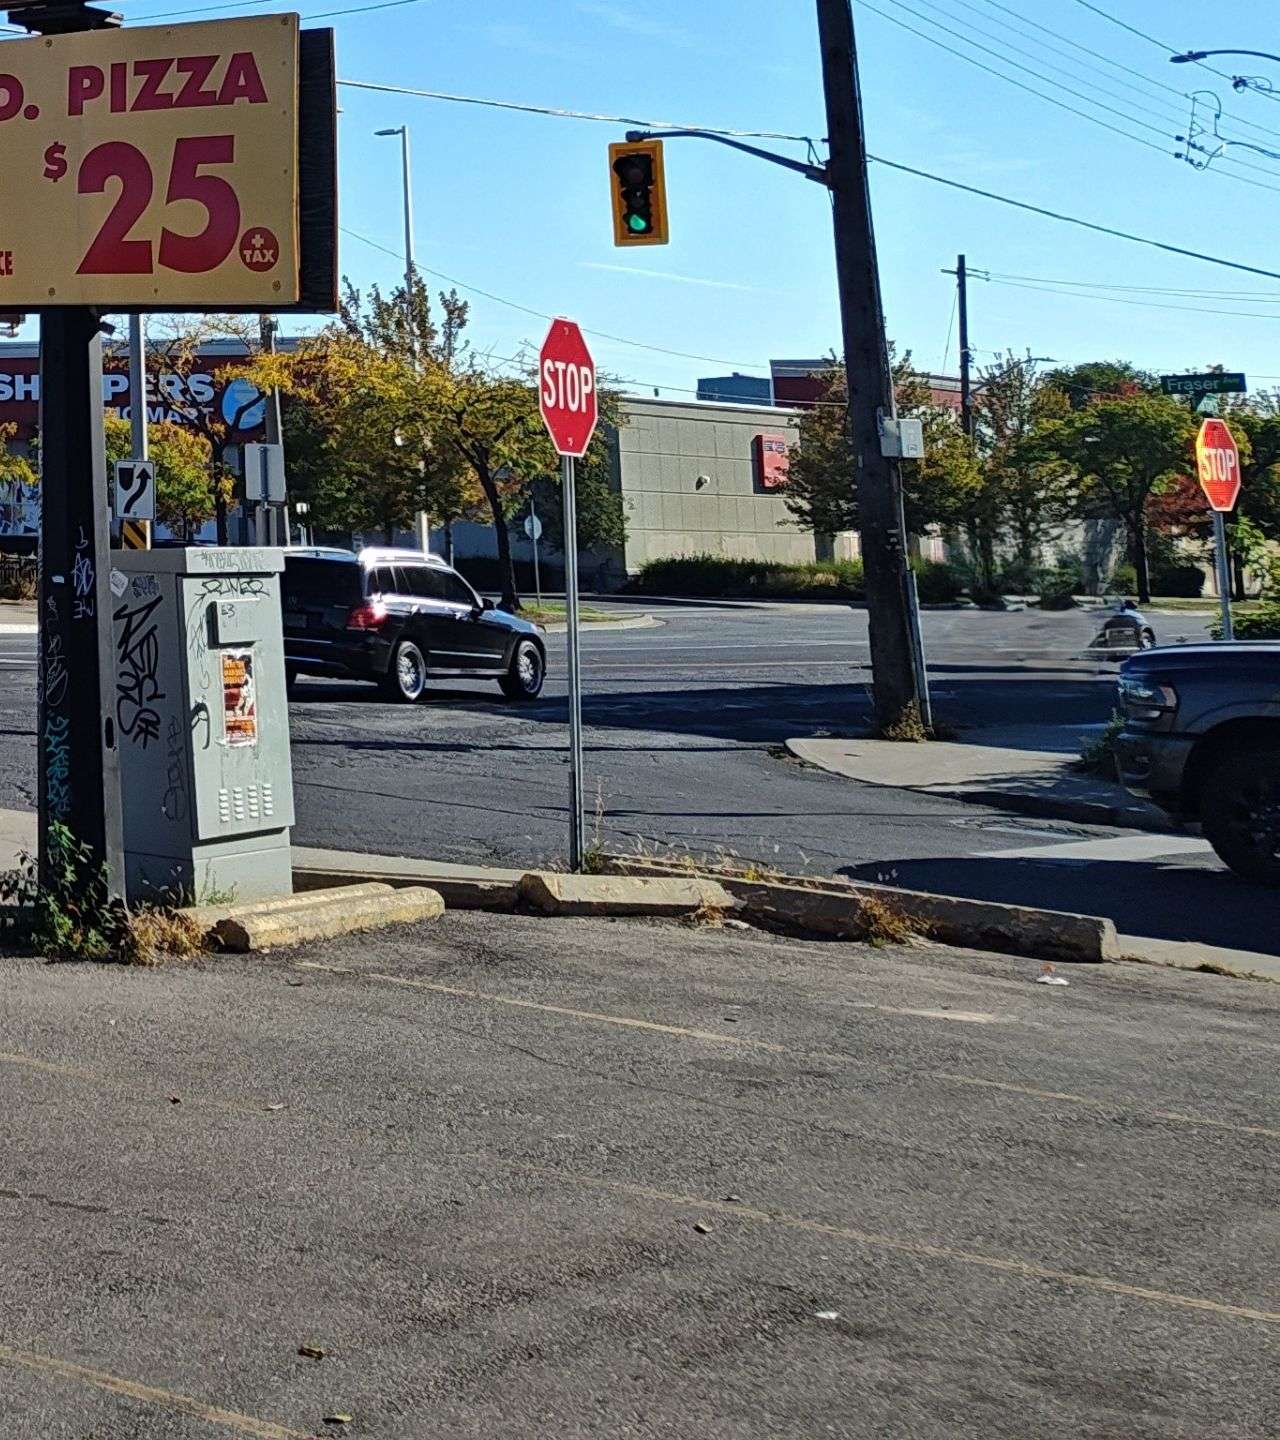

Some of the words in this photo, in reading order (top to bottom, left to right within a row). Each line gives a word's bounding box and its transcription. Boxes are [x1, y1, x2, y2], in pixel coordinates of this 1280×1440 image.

[68, 51, 269, 116] PIZZA
[243, 249, 275, 263] TAX
[543, 358, 593, 413] STOP
[1167, 377, 1219, 391] Fraser
[1200, 447, 1236, 481] STOP
